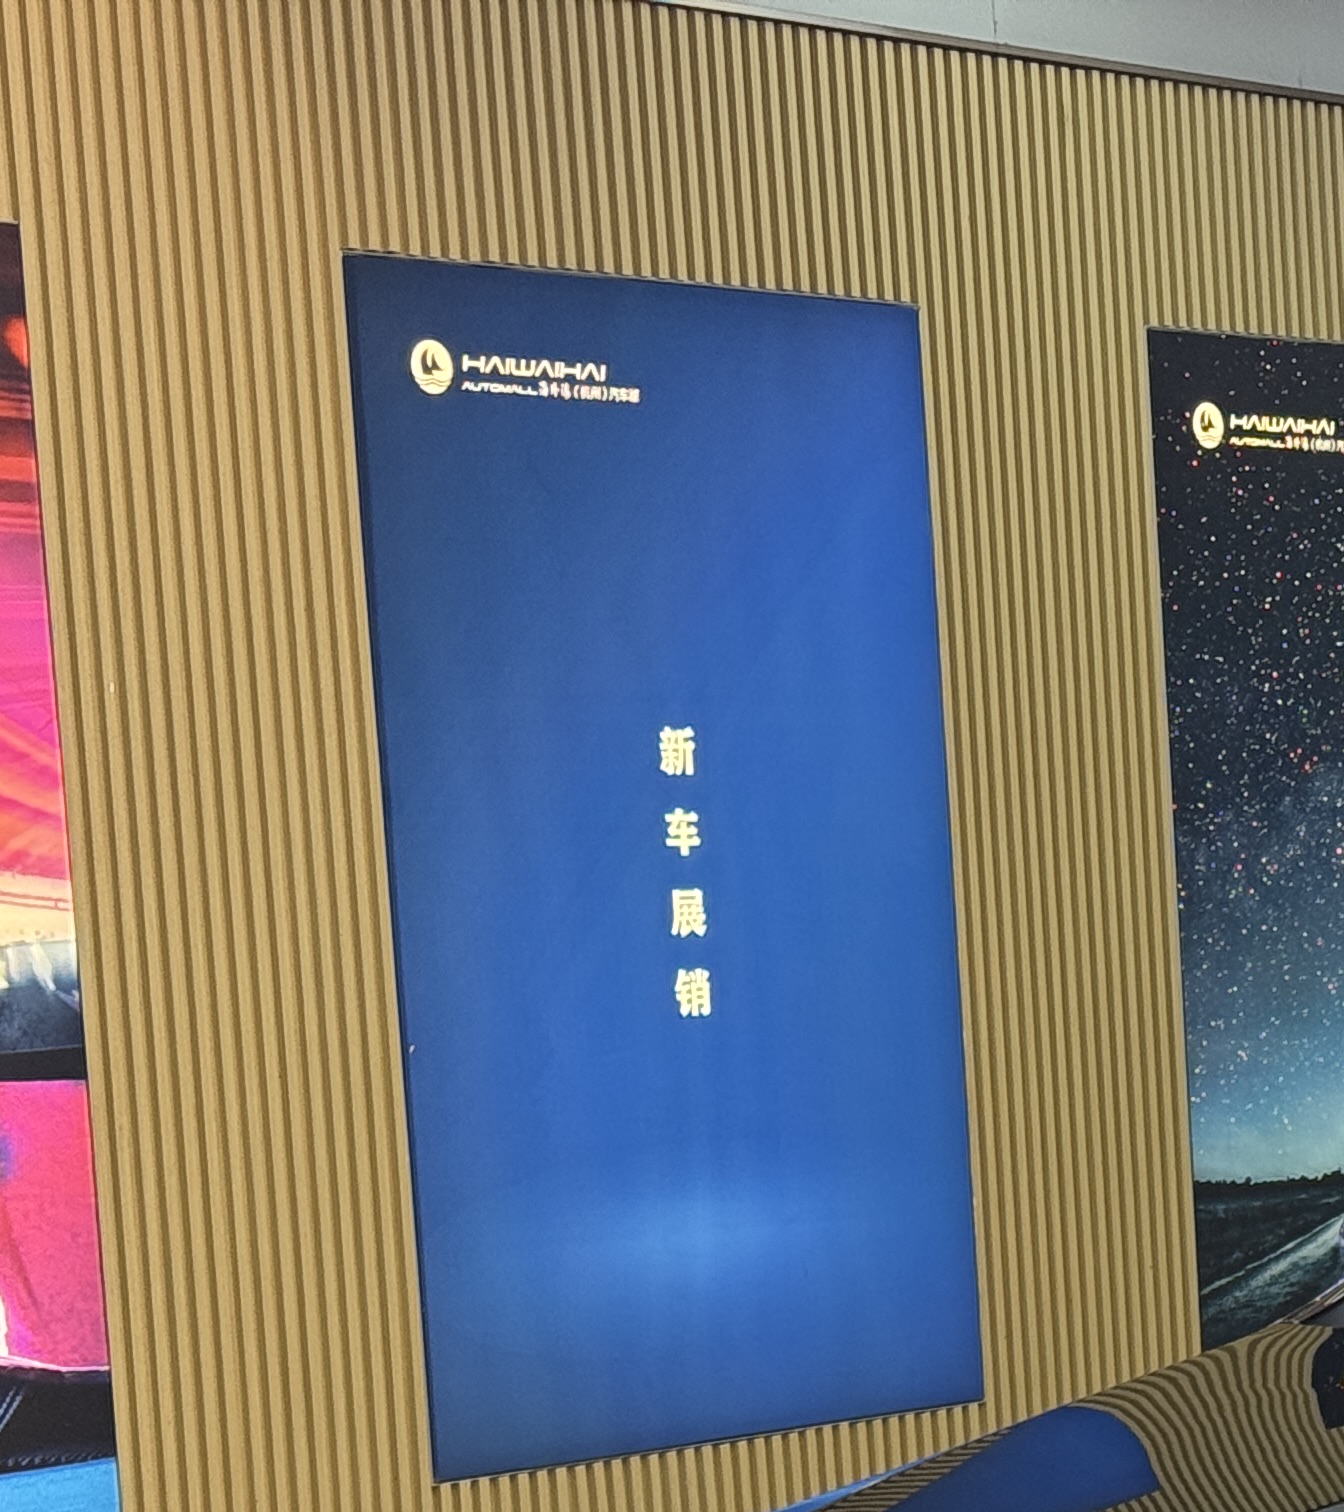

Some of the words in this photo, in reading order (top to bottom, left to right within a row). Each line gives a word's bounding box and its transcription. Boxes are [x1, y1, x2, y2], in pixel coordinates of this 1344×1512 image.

[462, 354, 607, 382] HAIWAIHAI
[1230, 413, 1336, 436] HAIWAIHAI
[659, 726, 712, 1018] 新车展销
